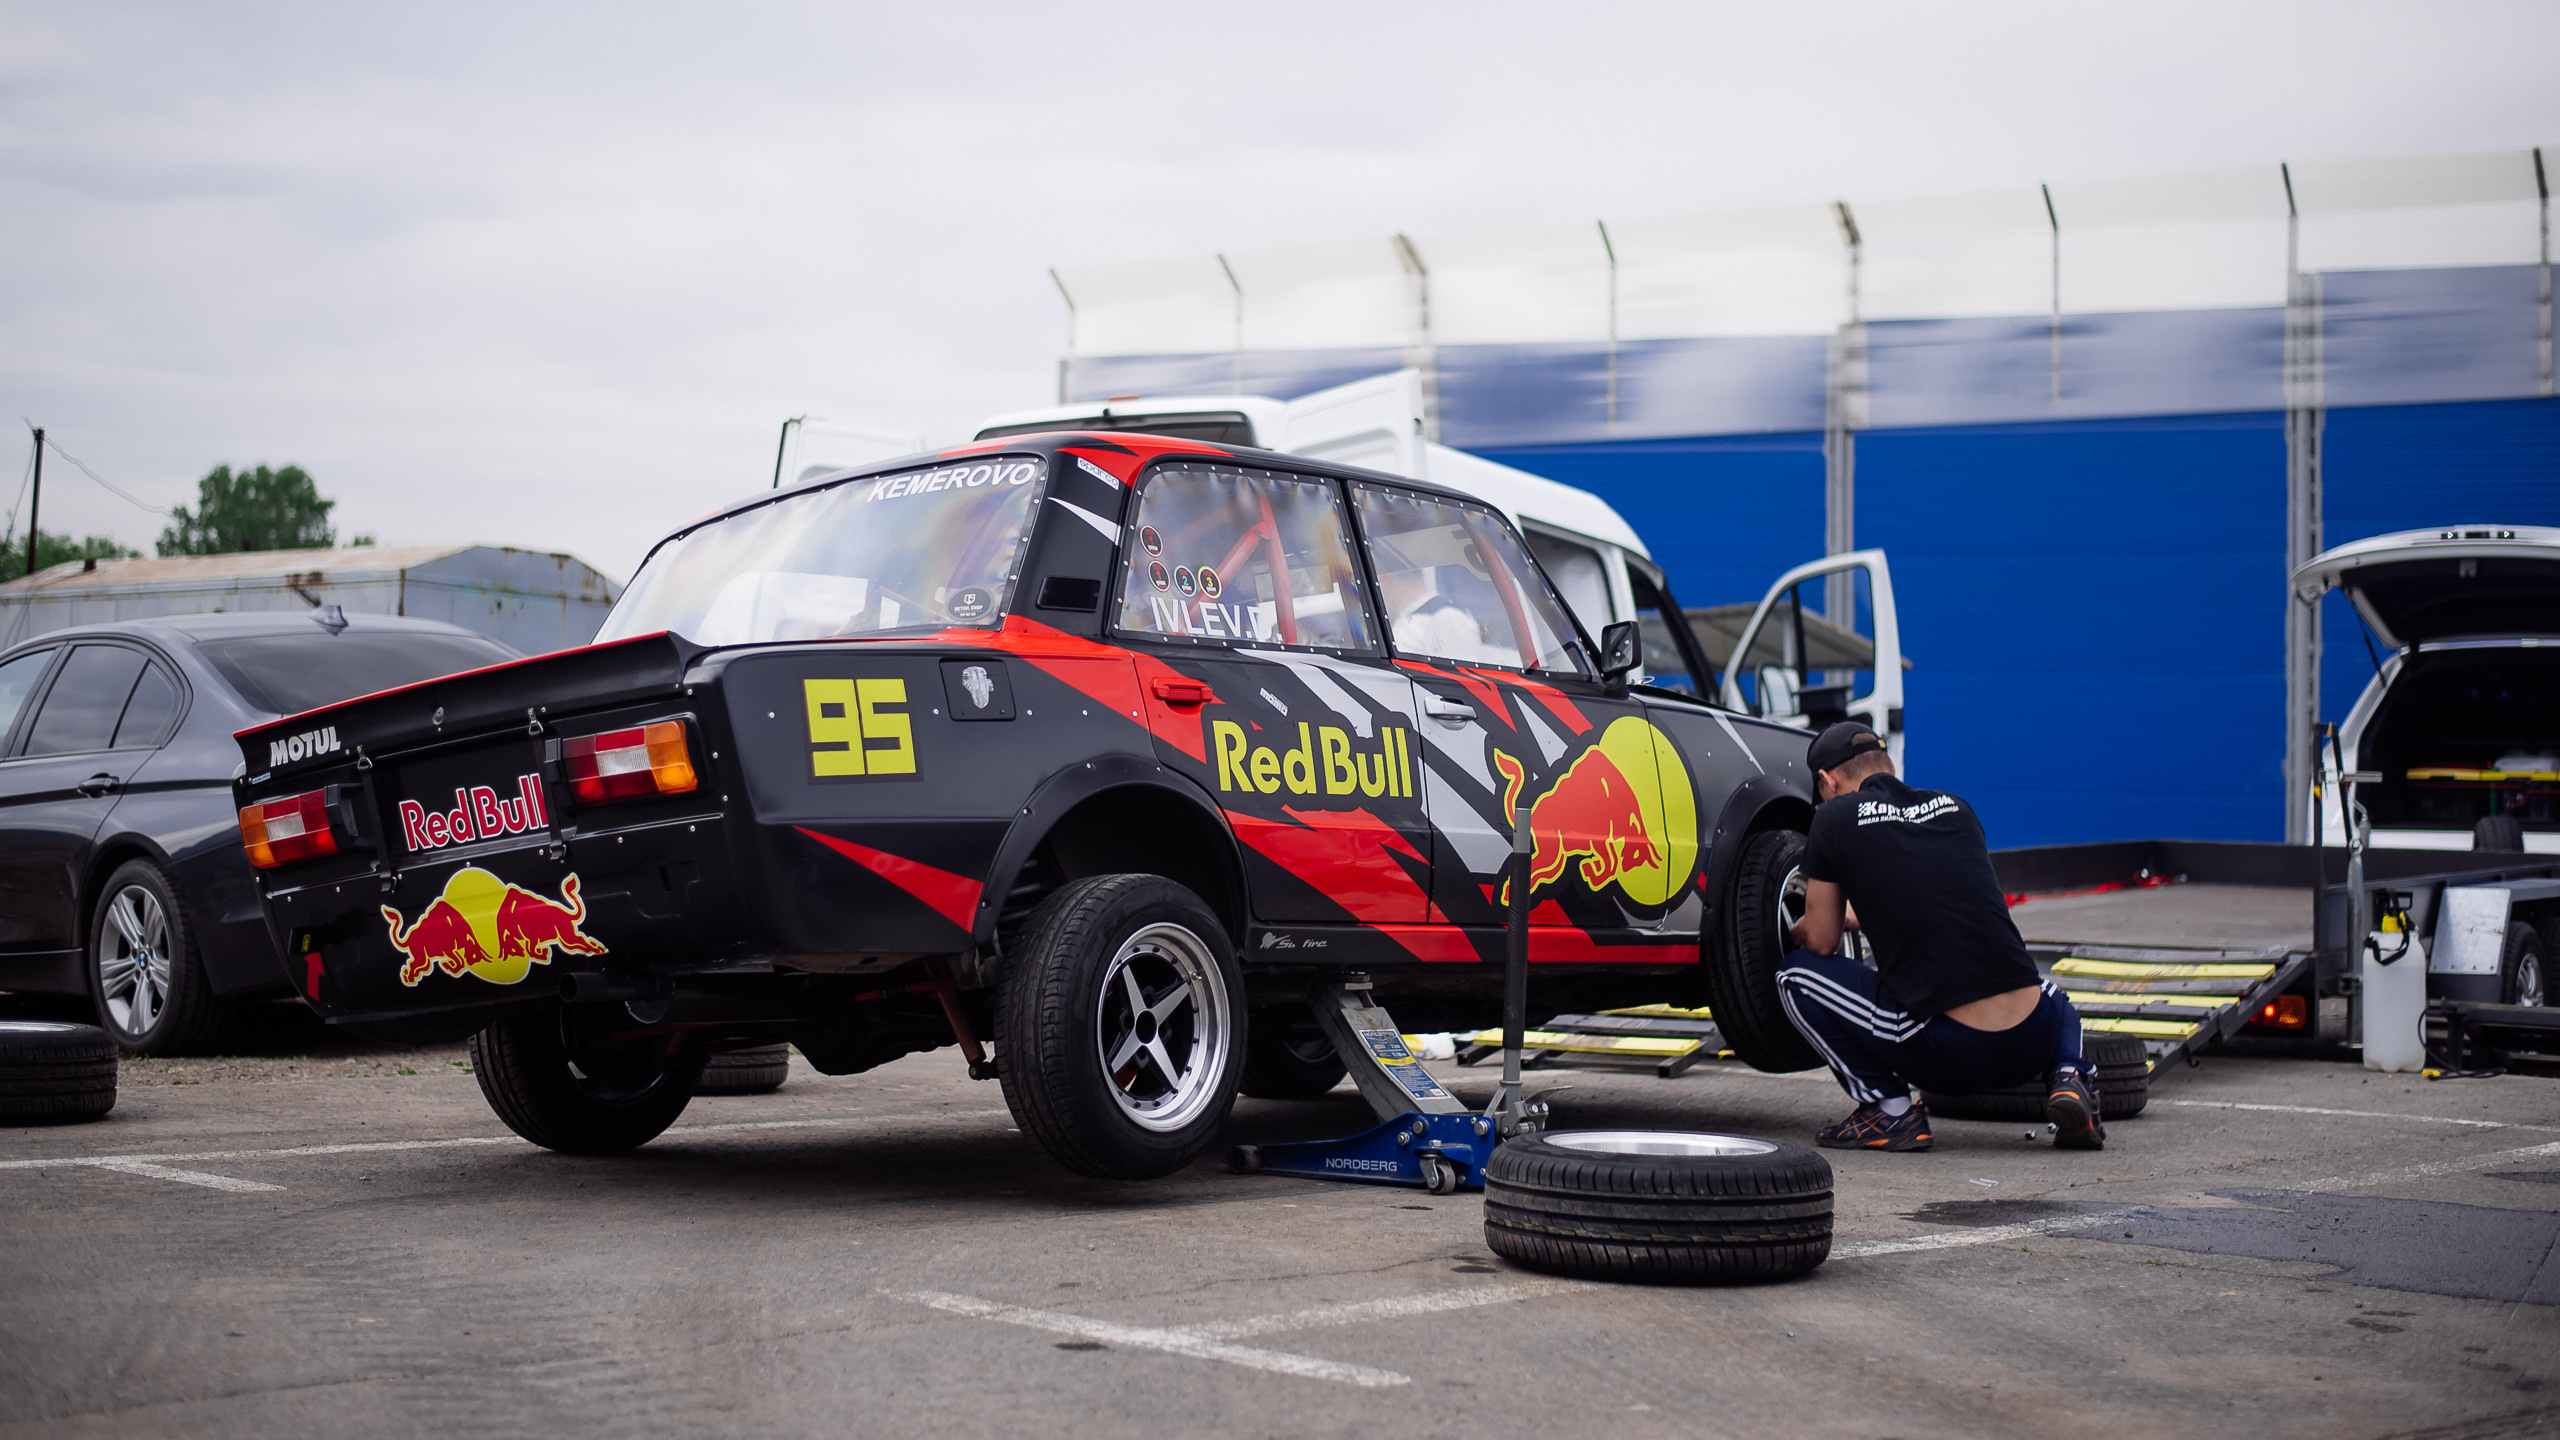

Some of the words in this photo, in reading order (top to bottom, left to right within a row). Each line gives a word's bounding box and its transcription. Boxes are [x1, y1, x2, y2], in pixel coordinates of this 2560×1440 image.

[866, 463, 1036, 503] KEMEROVO
[1079, 459, 1119, 487] sparco
[270, 725, 341, 768] MOTUL
[803, 678, 917, 777] 95
[1212, 720, 1317, 795] Red
[1318, 725, 1413, 798] Bull
[399, 788, 476, 851] Red
[470, 772, 549, 839] Bull
[1325, 1157, 1397, 1172] NORDBERG
